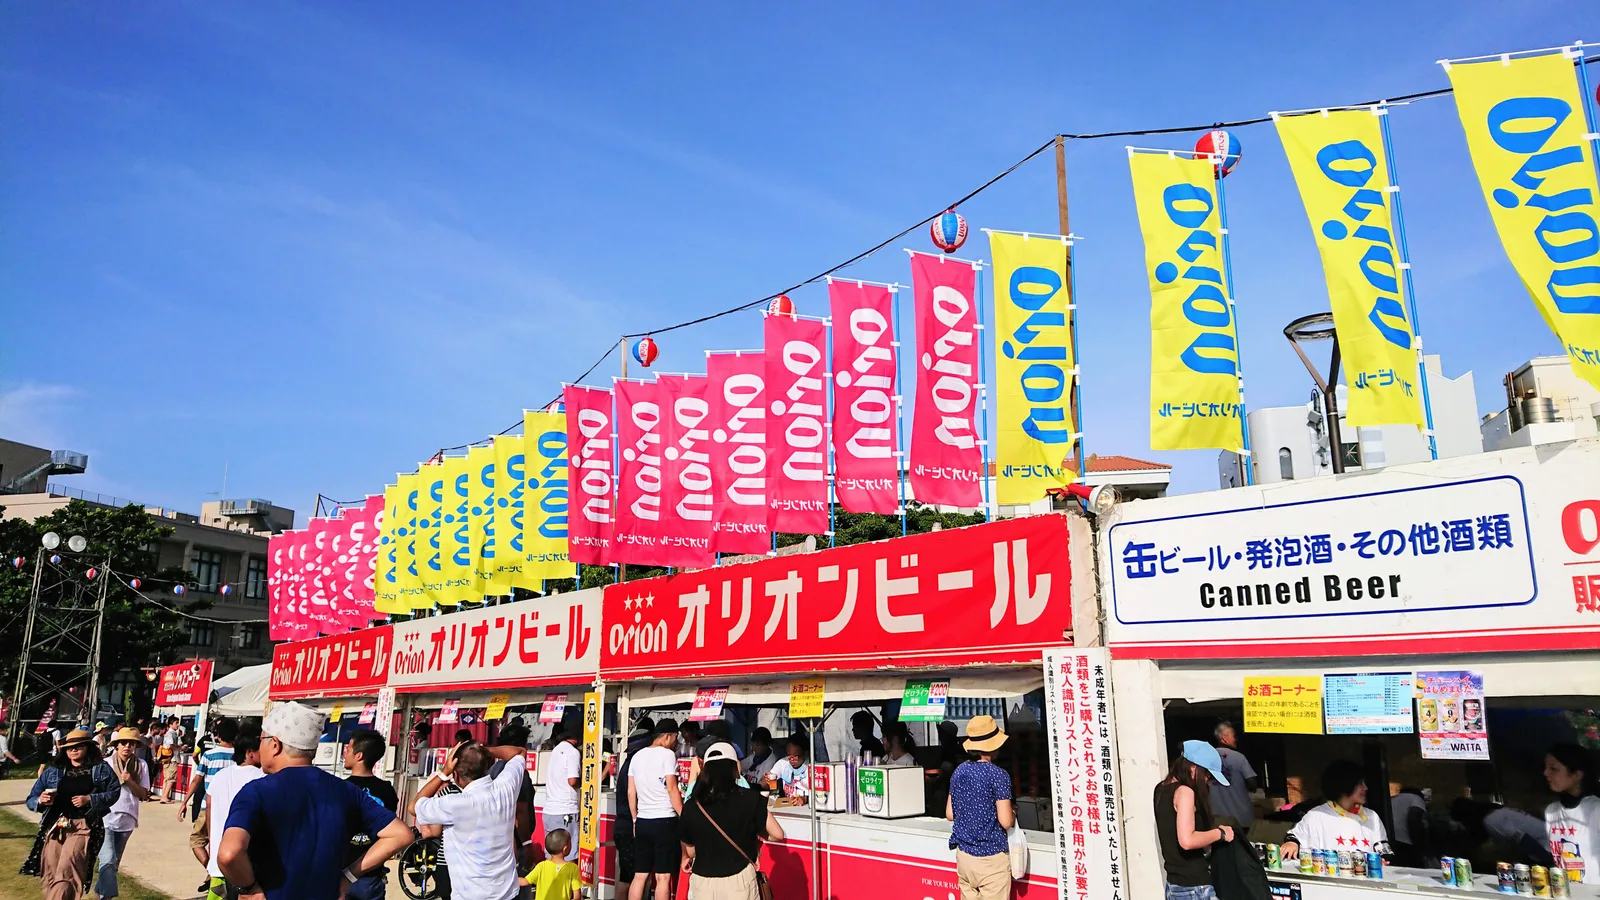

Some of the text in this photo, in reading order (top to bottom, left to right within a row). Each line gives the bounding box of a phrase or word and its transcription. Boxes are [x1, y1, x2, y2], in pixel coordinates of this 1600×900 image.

[1121, 513, 1514, 579] 缶ビール・発泡酒・その他酒類
[676, 538, 1052, 649] オリオンビール
[1199, 574, 1401, 609] Canned Beer
[292, 635, 387, 683] オリオンビール
[427, 604, 591, 672] オリオンビール
[1248, 684, 1317, 697] お酒コーナー
[1075, 655, 1101, 835] 酒類をご購入されるお客様は
[1450, 743, 1482, 752] WATTA
[921, 877, 932, 885] FOR
[932, 880, 948, 889] YOUR
